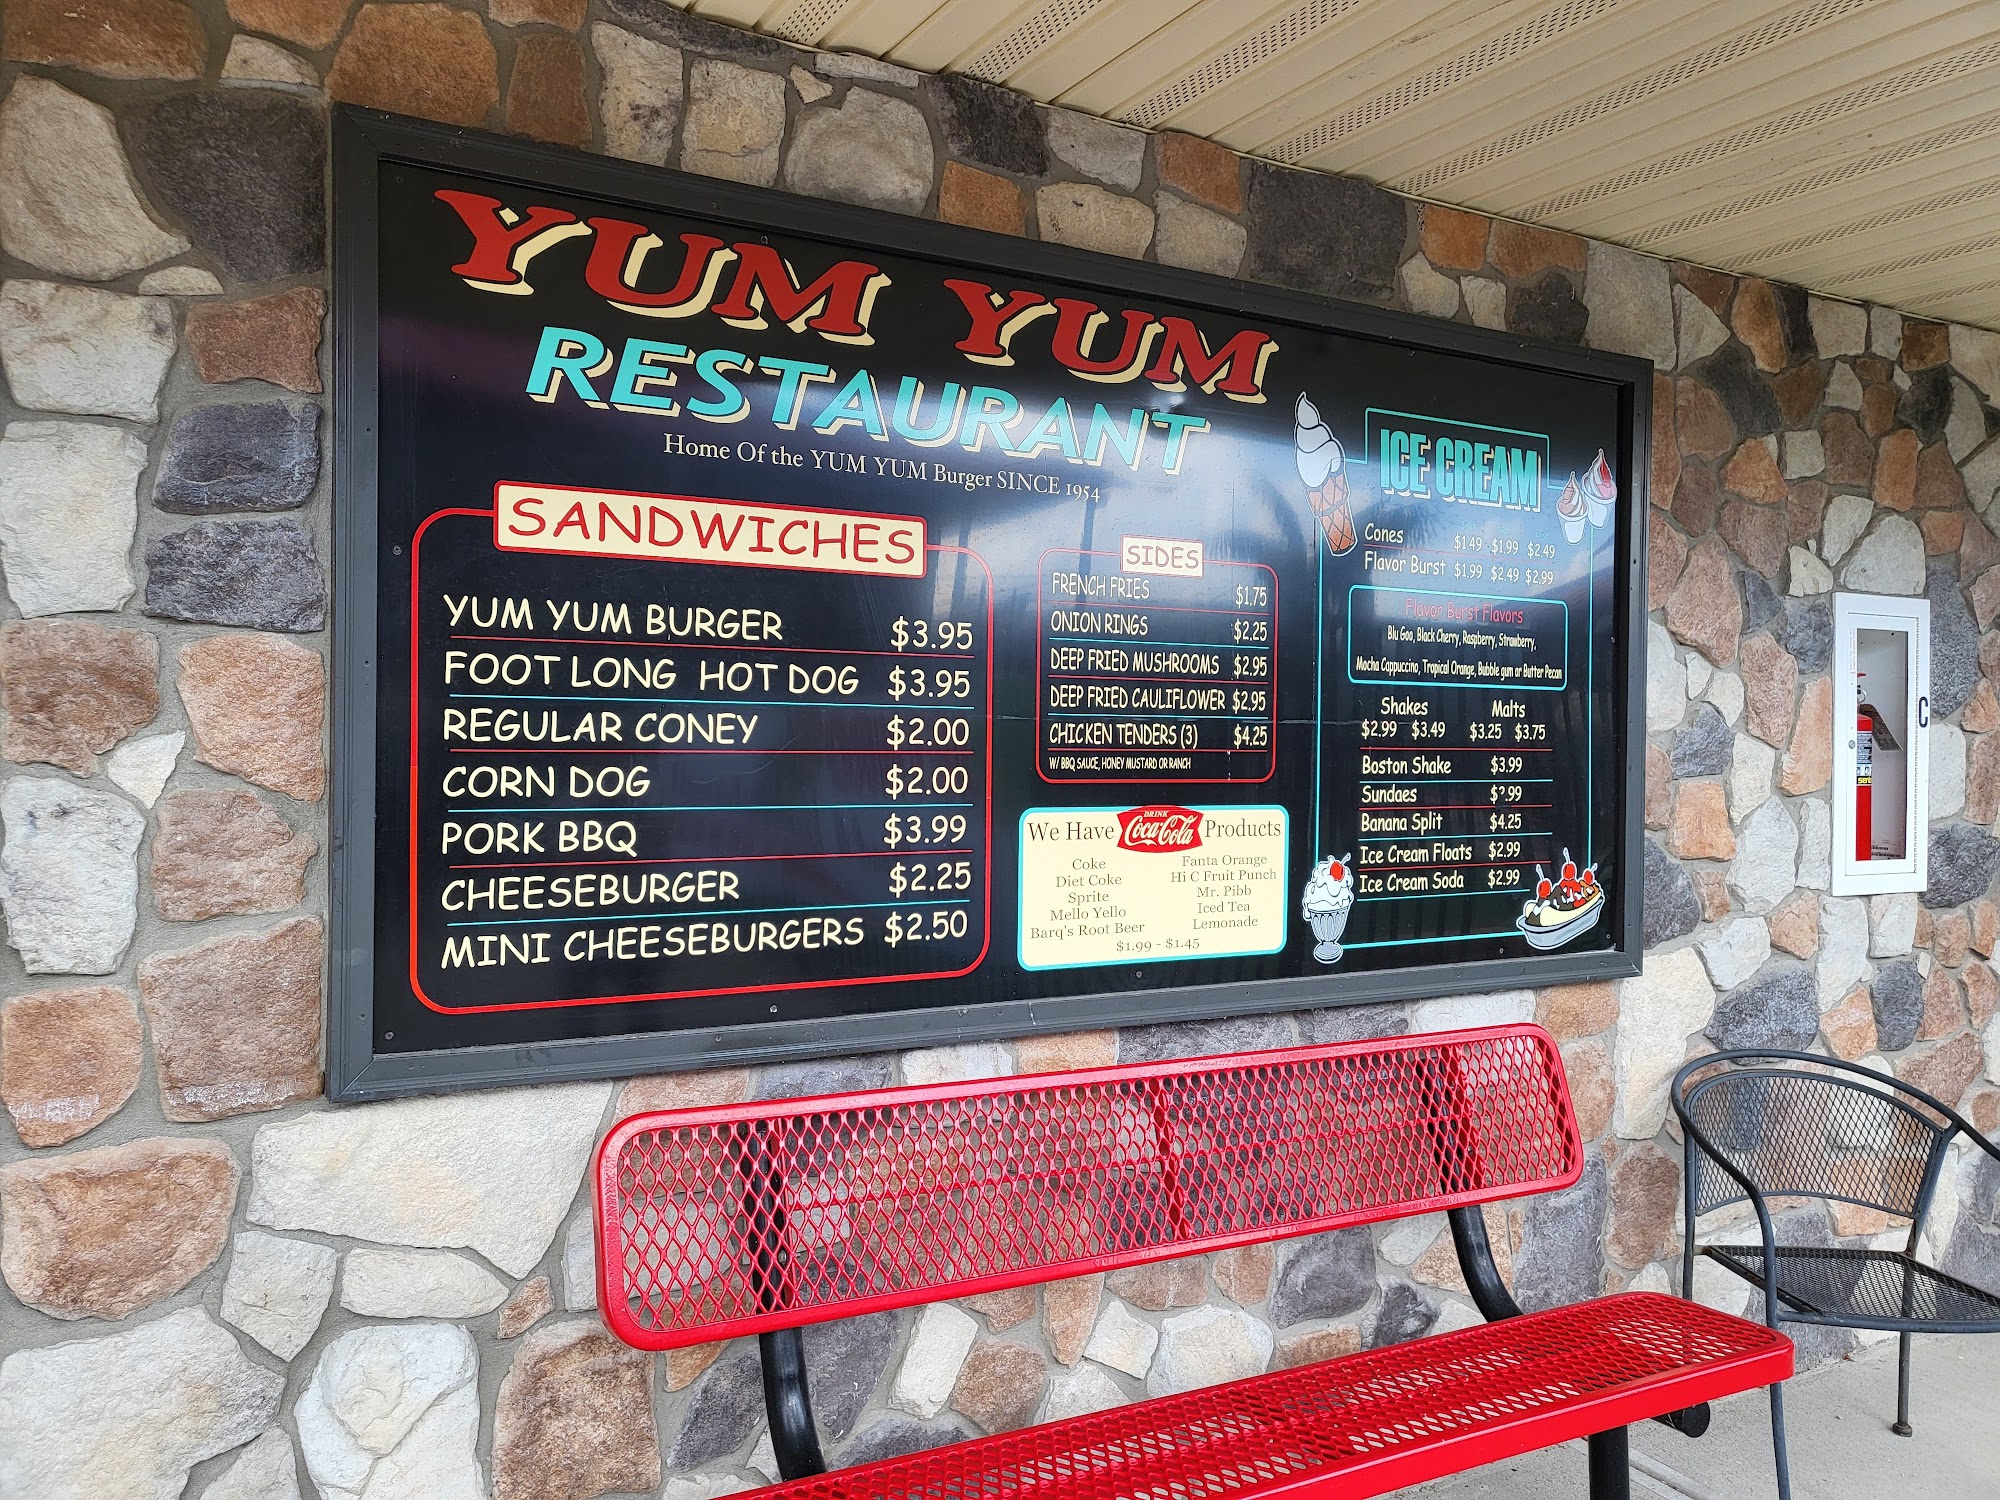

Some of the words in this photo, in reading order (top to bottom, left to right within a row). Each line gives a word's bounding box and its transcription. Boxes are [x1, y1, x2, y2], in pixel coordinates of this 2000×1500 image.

[434, 189, 892, 346] YUM
[943, 279, 1279, 404] YUM
[525, 325, 1211, 476] RESTAURANT
[664, 433, 730, 459] Home
[737, 441, 767, 462] Of
[772, 447, 803, 467] the
[810, 449, 866, 474] YUM
[873, 456, 927, 480] YUM
[933, 463, 993, 491] Burger
[997, 471, 1060, 496] SINCE
[1065, 483, 1100, 503] 1954
[1380, 428, 1431, 499] ICE
[1435, 437, 1541, 512] CREAM
[508, 497, 915, 564] SANDWICHES
[1365, 523, 1404, 544] Cones
[1454, 533, 1482, 551] $1.49
[1491, 538, 1519, 555] $1.99
[1527, 541, 1555, 559] $2.49
[1126, 545, 1200, 570] SIDES
[1364, 551, 1406, 572] Flavor
[1411, 555, 1446, 576] Burst
[1454, 561, 1482, 579] $1.99
[1491, 565, 1519, 583] $2.49
[1525, 567, 1554, 585] $2.99
[1052, 572, 1106, 597] FRENCH
[1110, 576, 1150, 599] FRIES
[1236, 583, 1267, 608] $1.75
[443, 594, 534, 631] YUM
[546, 599, 633, 635] YUM
[646, 603, 783, 641] BURGER
[891, 616, 974, 653] $3.95
[1405, 599, 1443, 619] Flavor
[1447, 602, 1480, 621] Burst
[1482, 604, 1524, 624] Flavors
[1051, 610, 1101, 633] ONION
[1104, 613, 1148, 636] RINGS
[1233, 618, 1267, 644] $2.25
[444, 650, 561, 686] FOOT
[571, 656, 677, 688] LONG
[700, 660, 778, 692] HOT
[789, 664, 859, 695] DOG
[888, 665, 971, 701] $3.95
[1050, 647, 1084, 671] DEEP
[1088, 649, 1128, 672] FRIED
[1132, 651, 1220, 675] MUSHROOMS
[1233, 653, 1267, 679] $2.95
[1356, 655, 1380, 672] Mocha
[1381, 657, 1421, 676] Cappuccino,
[1422, 658, 1449, 678] Tropical
[1450, 660, 1477, 680] Orange,
[1478, 661, 1500, 677] Bubble
[1500, 667, 1514, 681] gum
[1515, 667, 1522, 678] or
[1523, 663, 1544, 679] Butter
[1544, 664, 1563, 680] Pecan
[1050, 684, 1084, 708] DEEP
[1087, 685, 1128, 708] FRIED
[1132, 687, 1226, 711] CAULIFLOWER
[1232, 688, 1266, 714] $2.95
[1380, 696, 1428, 716] Shakes
[1491, 699, 1526, 718] Malts
[443, 709, 622, 743] REGULAR
[635, 712, 758, 745] CONEY
[886, 714, 970, 751] $2.00
[1049, 722, 1112, 744] CHICKEN
[1116, 724, 1177, 746] TENDERS
[1180, 724, 1198, 749] (3)
[1234, 724, 1267, 749] $4.25
[1361, 719, 1397, 740] $2.99
[1411, 719, 1446, 741] $3.49
[1469, 721, 1502, 742] $3.25
[1514, 722, 1546, 743] $3.75
[1049, 756, 1060, 770] W/
[1060, 757, 1075, 772] BBQ
[1076, 757, 1100, 771] SAUCE,
[1101, 757, 1124, 770] HONEY
[1125, 757, 1157, 770] MUSTARD
[1159, 757, 1168, 770] OR
[1169, 757, 1191, 770] RANCH
[1362, 755, 1408, 774] Boston
[1411, 755, 1452, 775] Shake
[1490, 755, 1523, 775] $3.99
[442, 766, 554, 798] CORN
[569, 766, 650, 798] DOG
[885, 763, 968, 799] $2.00
[1361, 783, 1417, 803] Sundaes
[442, 821, 545, 854] PORK
[558, 820, 637, 858] BBQ
[883, 812, 967, 849] $3.99
[1027, 822, 1059, 841] We
[1066, 821, 1115, 840] Have
[1205, 818, 1281, 837] Products
[1361, 812, 1407, 832] Banana
[1411, 811, 1443, 836] Split
[1489, 812, 1522, 832] $4.25
[1072, 857, 1106, 870] Coke
[1182, 855, 1218, 866] Fanta
[1222, 854, 1267, 867] Orange
[1360, 846, 1384, 864] Ice
[1387, 844, 1429, 863] Cream
[1433, 842, 1472, 862] Floats
[1488, 841, 1521, 861] $2.99
[441, 870, 739, 911] CHEESEBURGER
[888, 861, 972, 898] $2.25
[1056, 875, 1084, 887] Diet
[1088, 873, 1122, 886] Coke
[1171, 871, 1186, 882] Hi
[1190, 871, 1199, 882] C
[1204, 869, 1235, 881] Fruit
[1238, 868, 1277, 880] Punch
[1359, 874, 1383, 893] Ice
[1387, 873, 1428, 891] Cream
[1432, 870, 1464, 889] Soda
[1487, 868, 1520, 889] $2.99
[1068, 890, 1110, 906] Sprite
[1197, 887, 1219, 898] Mr.
[1223, 885, 1252, 897] Pibb
[1050, 907, 1089, 921] Mello
[1093, 905, 1126, 918] Yello
[1197, 901, 1224, 913] Iced
[1228, 901, 1250, 912] Tea
[1030, 925, 1074, 940] Barq's
[1078, 923, 1110, 936] Root
[1115, 922, 1145, 934] Beer
[1193, 916, 1259, 930] Lemonade
[441, 933, 551, 969] MINI
[563, 917, 865, 961] CHEESEBURGERS
[884, 910, 968, 948] $2.50
[1116, 940, 1152, 953] $1.99
[1165, 937, 1200, 950] $1.45
